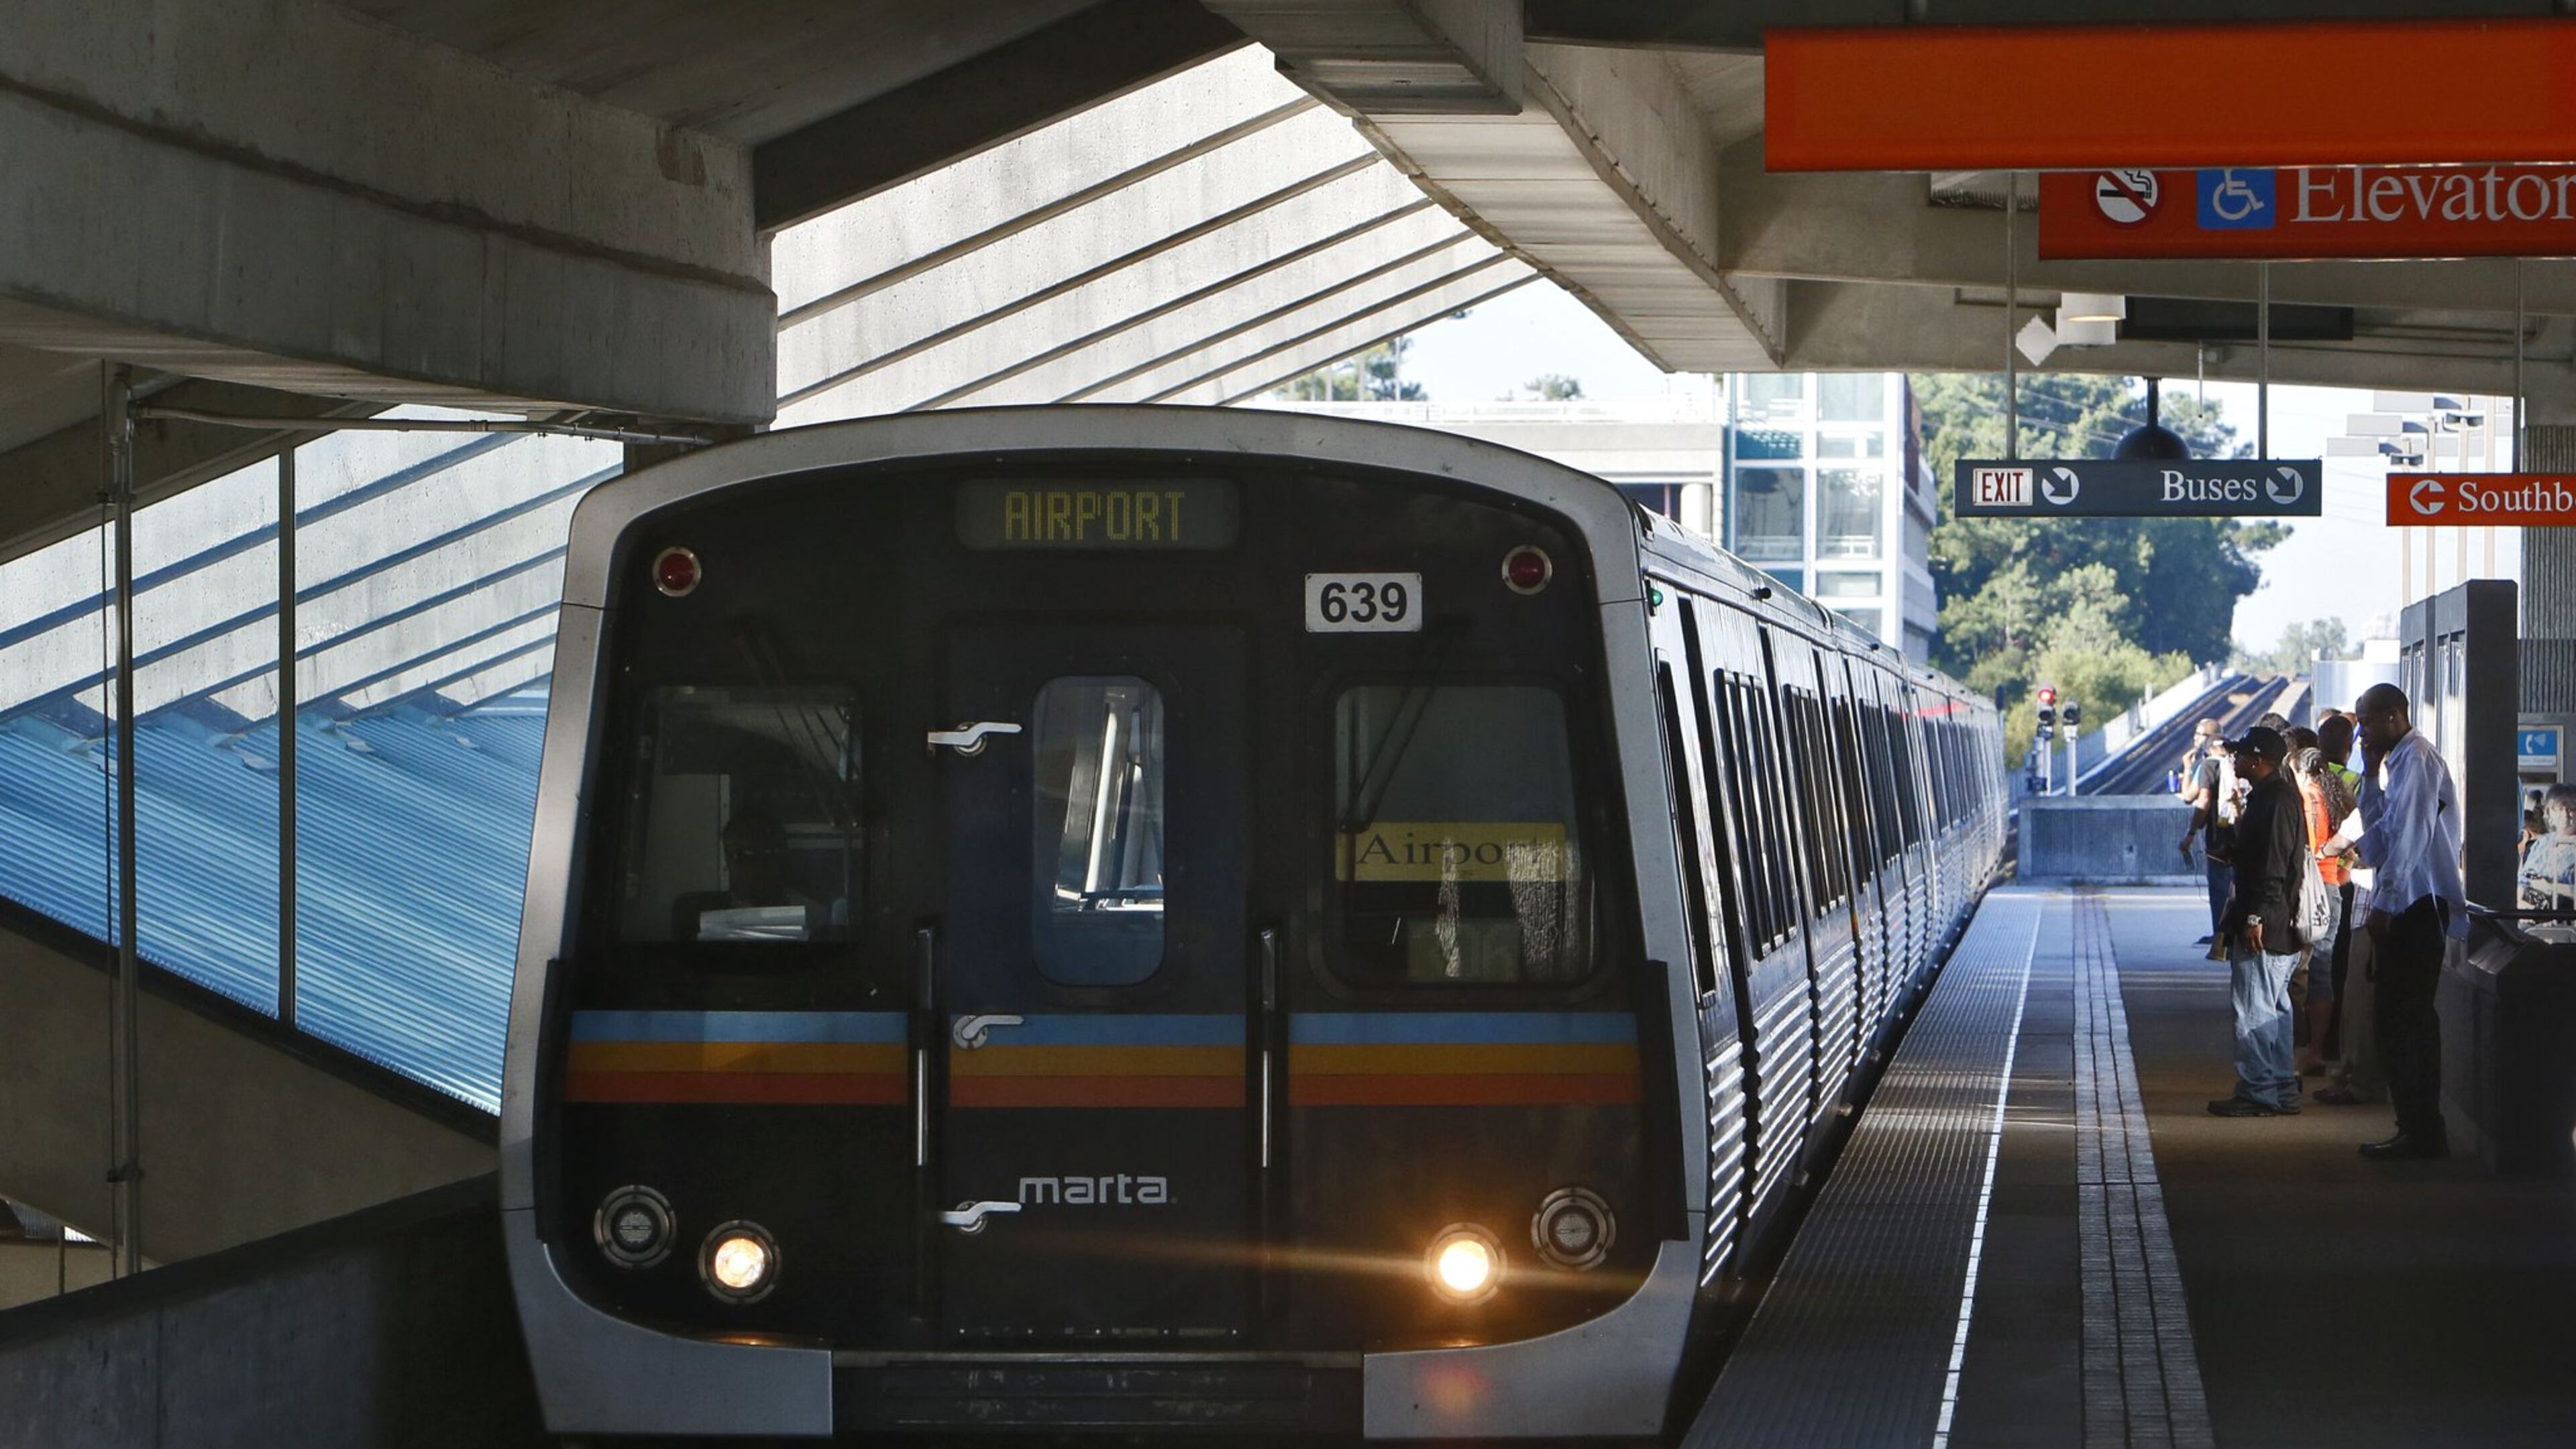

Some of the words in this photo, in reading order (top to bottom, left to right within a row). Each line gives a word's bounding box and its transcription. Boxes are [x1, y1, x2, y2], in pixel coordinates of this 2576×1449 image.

[1982, 472, 2024, 502] EXIT
[2160, 470, 2257, 501] Buses
[2458, 481, 2576, 512] Southb
[1006, 491, 1185, 541] AIRPORT
[1320, 582, 1408, 624] 639
[1018, 1173, 1167, 1204] marta
